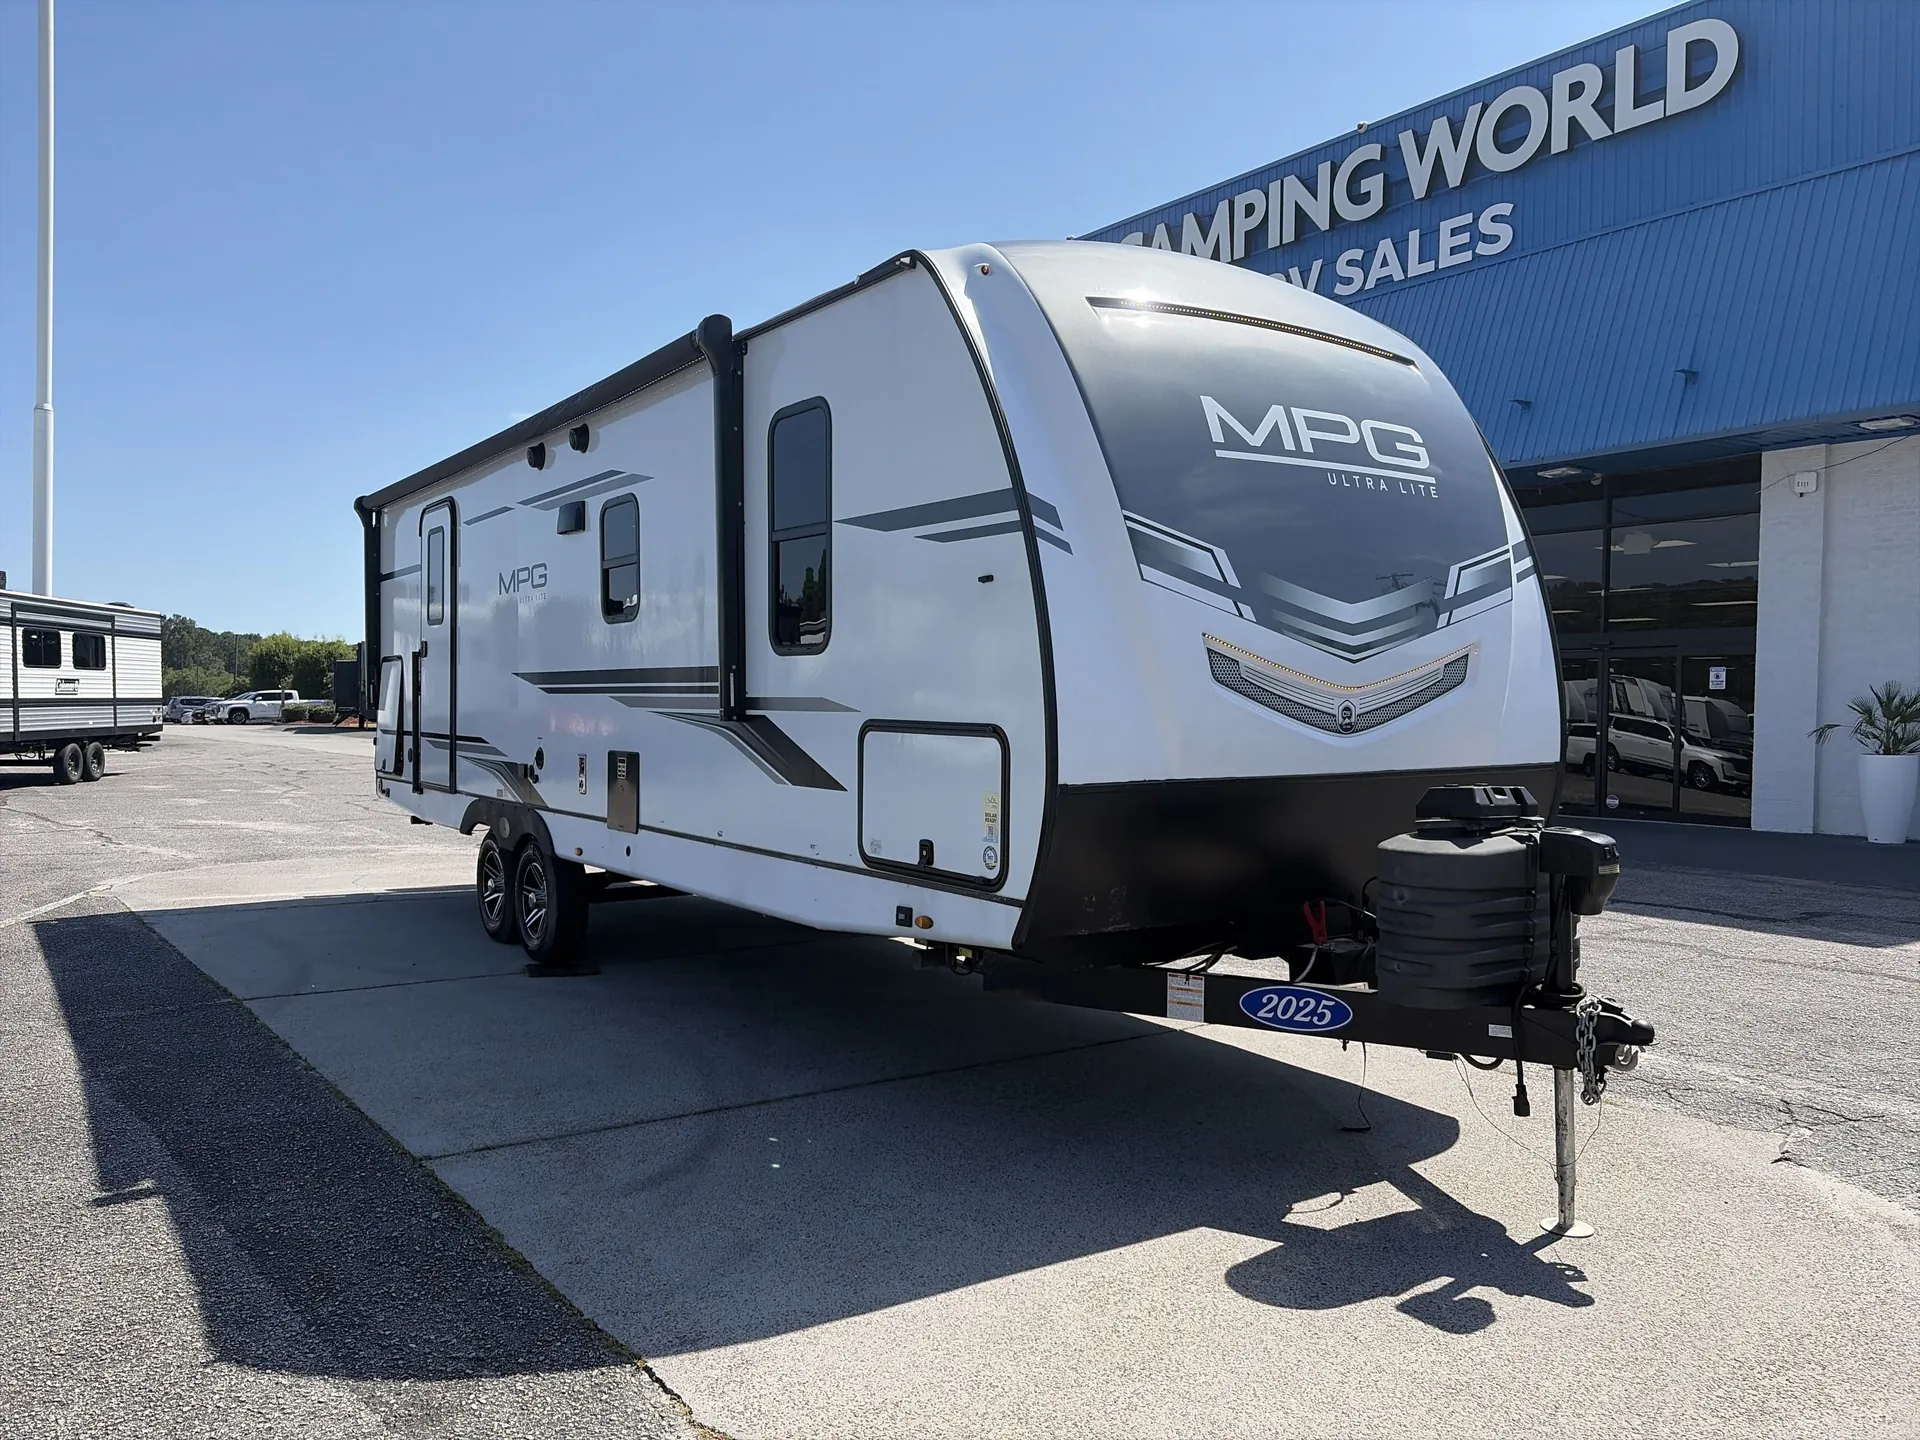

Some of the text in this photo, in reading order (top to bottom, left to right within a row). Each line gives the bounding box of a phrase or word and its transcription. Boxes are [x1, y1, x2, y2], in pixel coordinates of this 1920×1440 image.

[1398, 18, 1739, 200] WORLD
[1334, 202, 1515, 296] SALES
[1200, 395, 1430, 469] MPG
[1327, 472, 1439, 499] ULTRA LITE
[499, 562, 547, 595] MPG
[1257, 994, 1336, 1026] 2025
